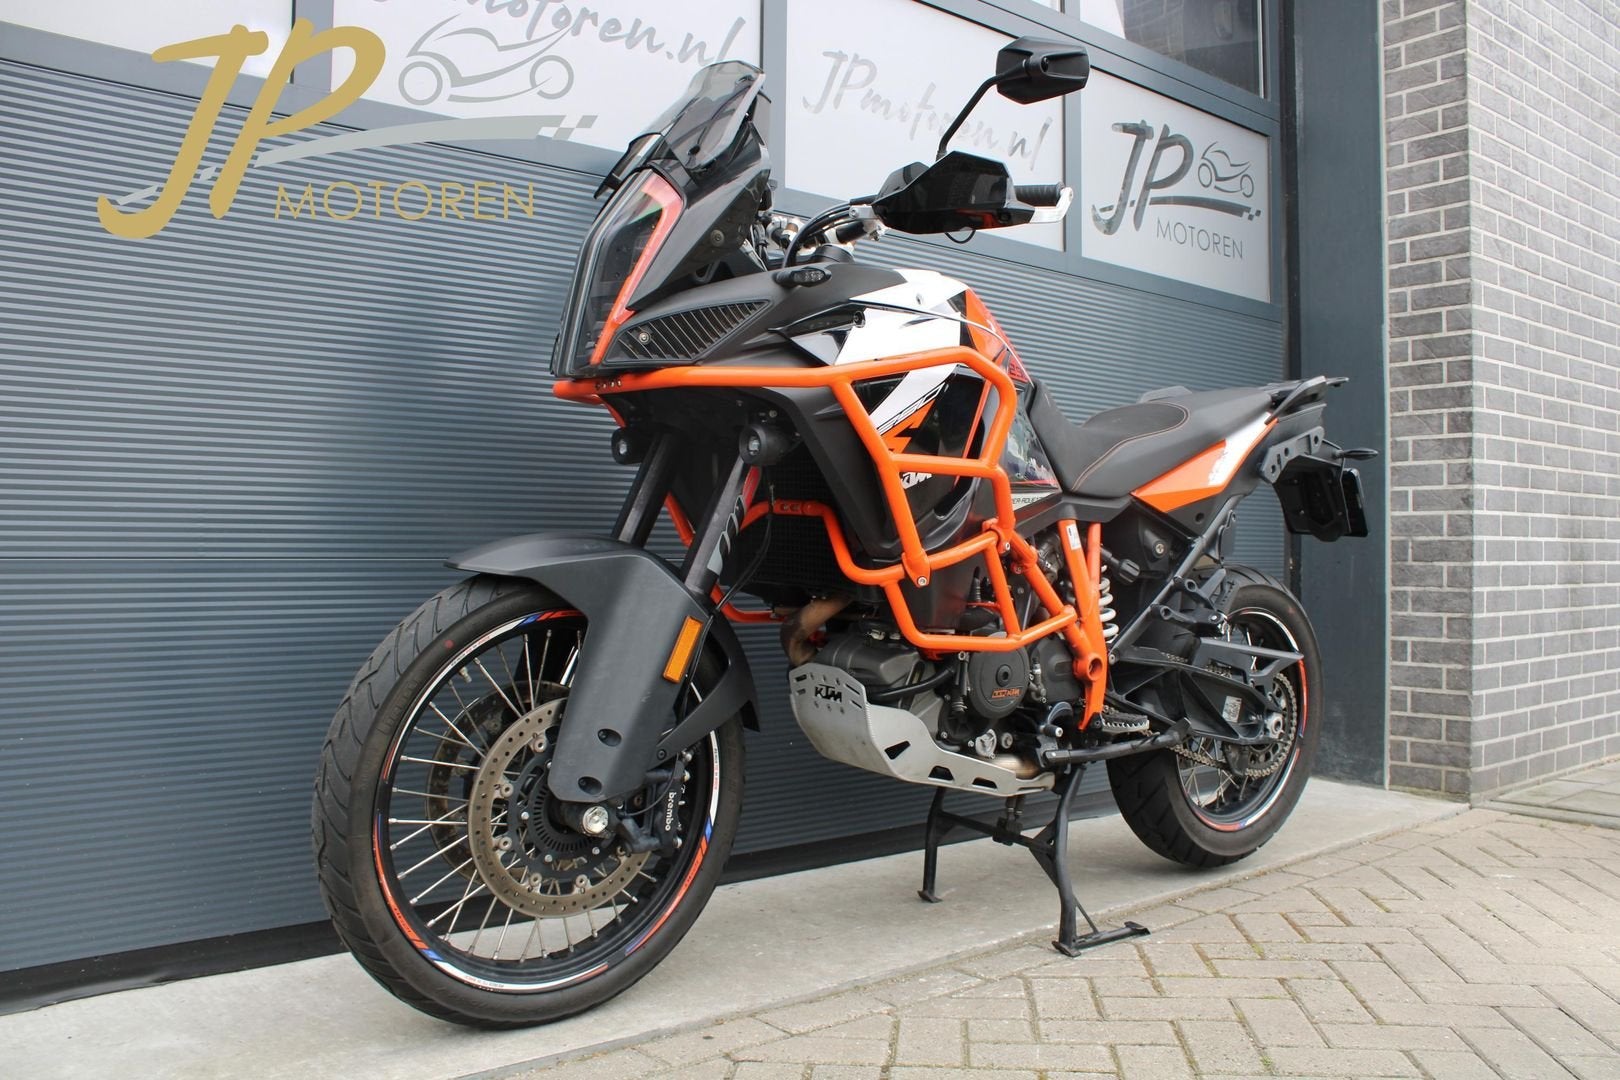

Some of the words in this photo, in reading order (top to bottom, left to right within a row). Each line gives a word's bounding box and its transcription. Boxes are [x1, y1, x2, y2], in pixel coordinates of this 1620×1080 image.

[1091, 119, 1194, 236] JP
[1156, 218, 1243, 259] MOTOREN
[815, 684, 842, 702] KTM
[664, 791, 677, 832] brembo
